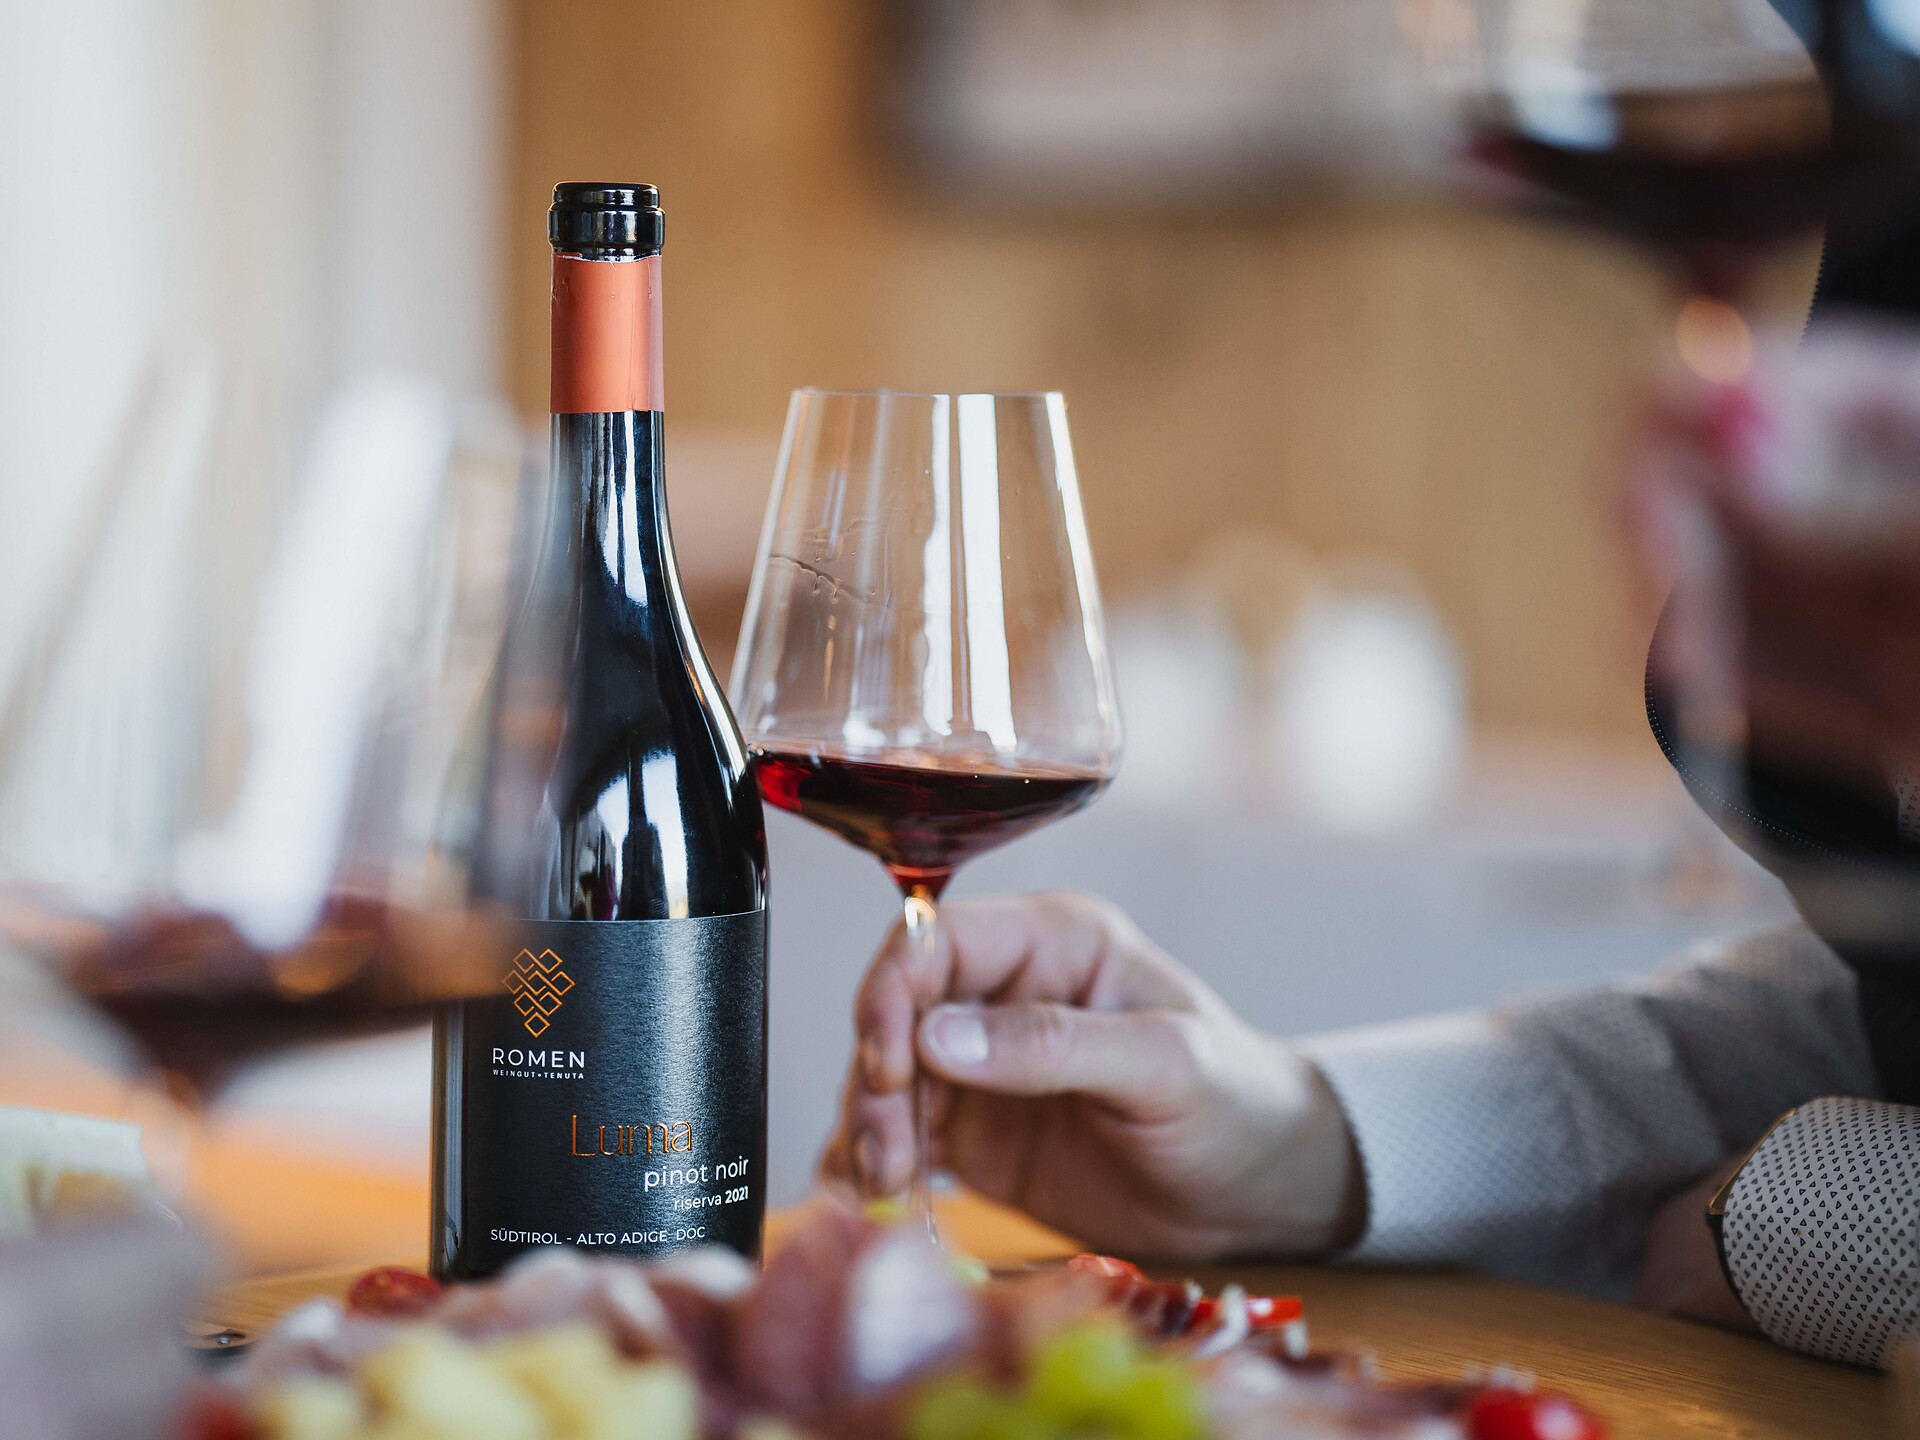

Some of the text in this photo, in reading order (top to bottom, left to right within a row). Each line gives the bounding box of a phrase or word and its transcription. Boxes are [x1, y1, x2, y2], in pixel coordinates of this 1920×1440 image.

[492, 1048, 585, 1068] ROMEN
[571, 1114, 693, 1157] Luma
[643, 1155, 749, 1192] pinot noir
[673, 1185, 749, 1211] riserva 2021
[490, 1228, 562, 1245] SÜDTIROL
[576, 1232, 616, 1245] ALTO
[621, 1230, 668, 1243] ADIGE
[676, 1227, 706, 1241] DOC
